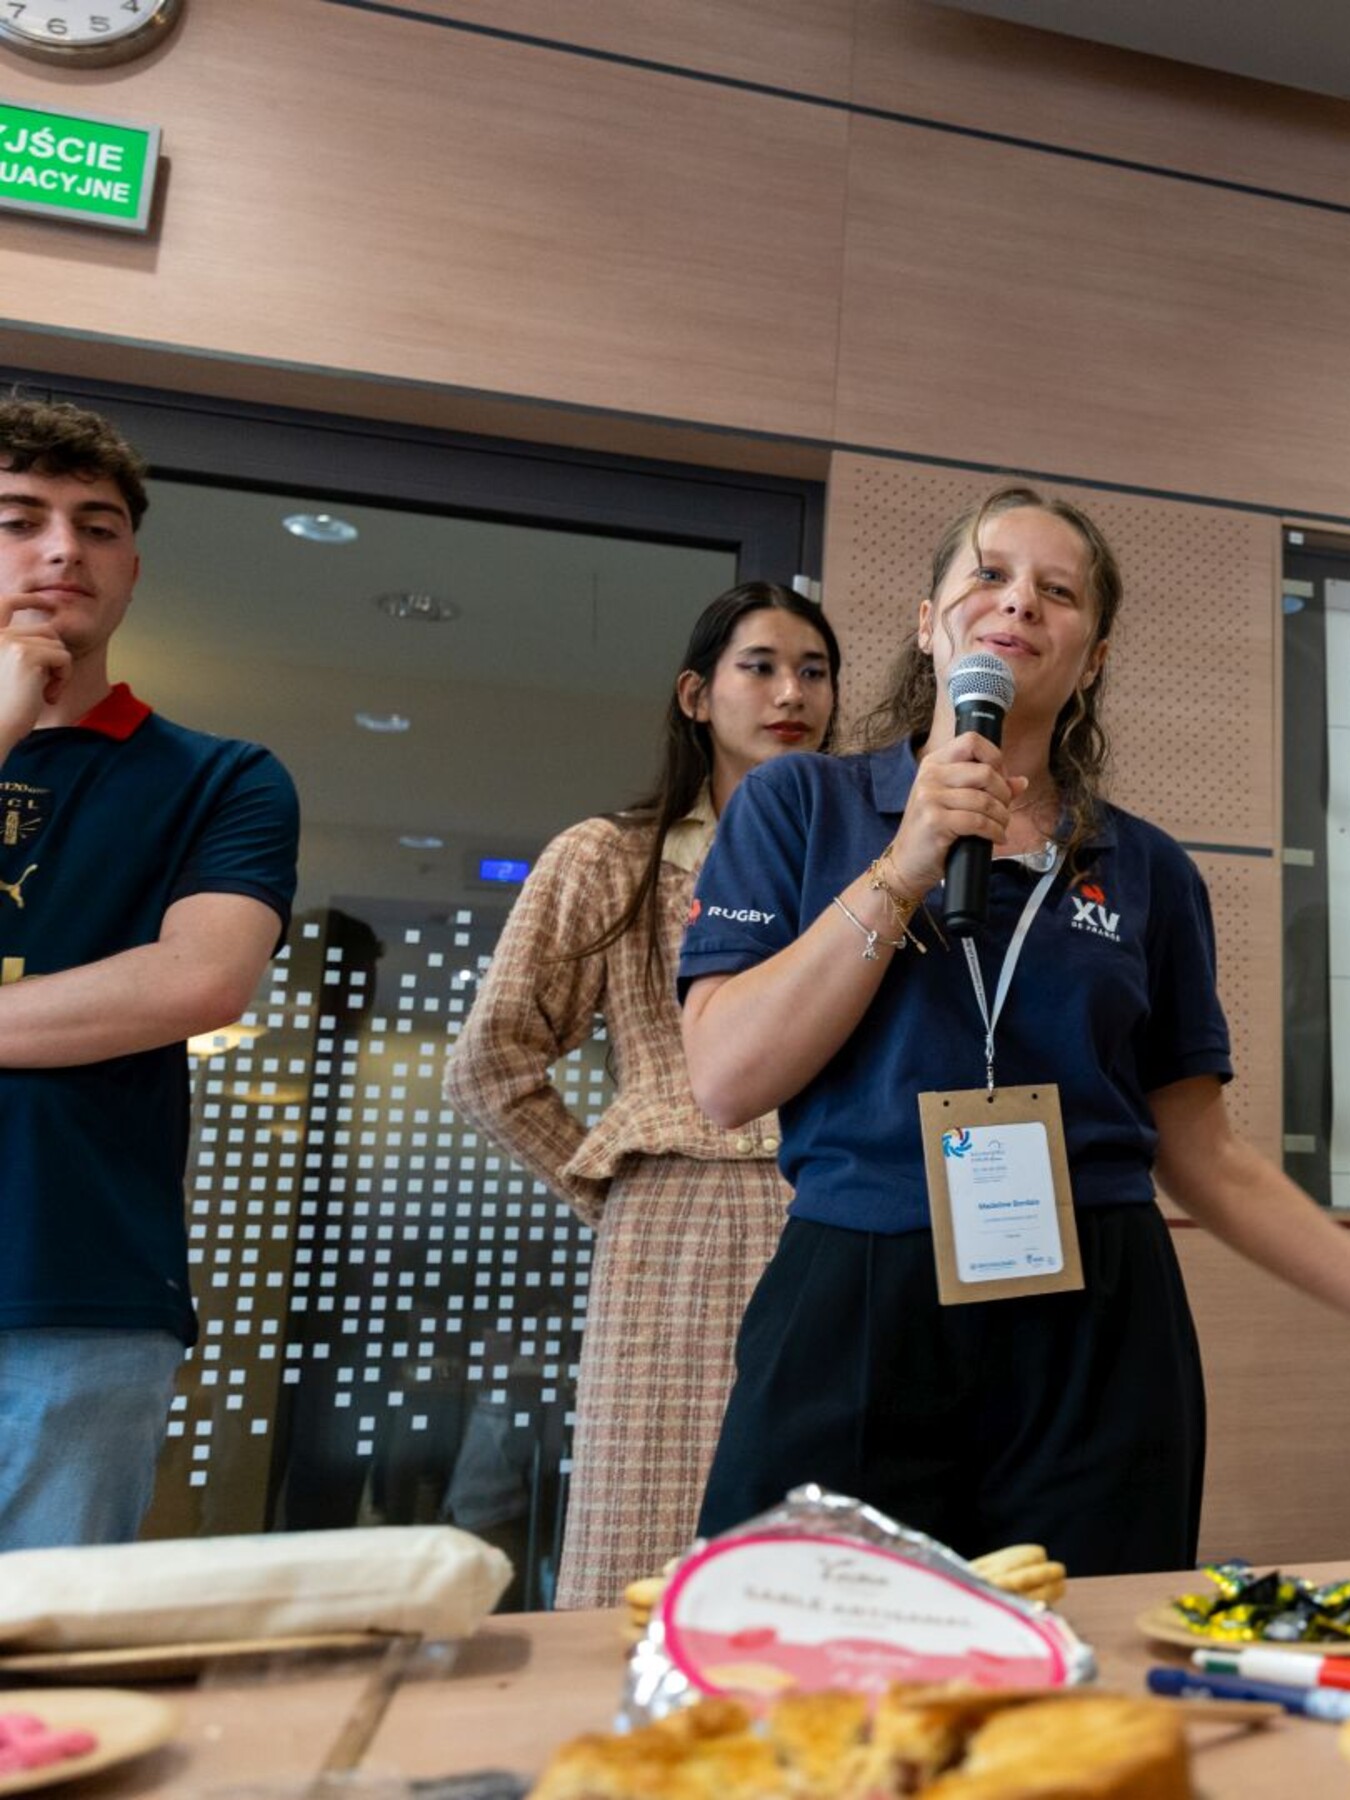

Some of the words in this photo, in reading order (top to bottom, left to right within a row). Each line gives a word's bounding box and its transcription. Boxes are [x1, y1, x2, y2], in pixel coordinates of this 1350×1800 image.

[7, 2, 26, 18] 7
[46, 18, 67, 35] 6
[89, 14, 110, 33] 5
[0, 125, 124, 172] JŚCIE
[708, 906, 775, 924] RUGBY
[1071, 896, 1120, 932] XV
